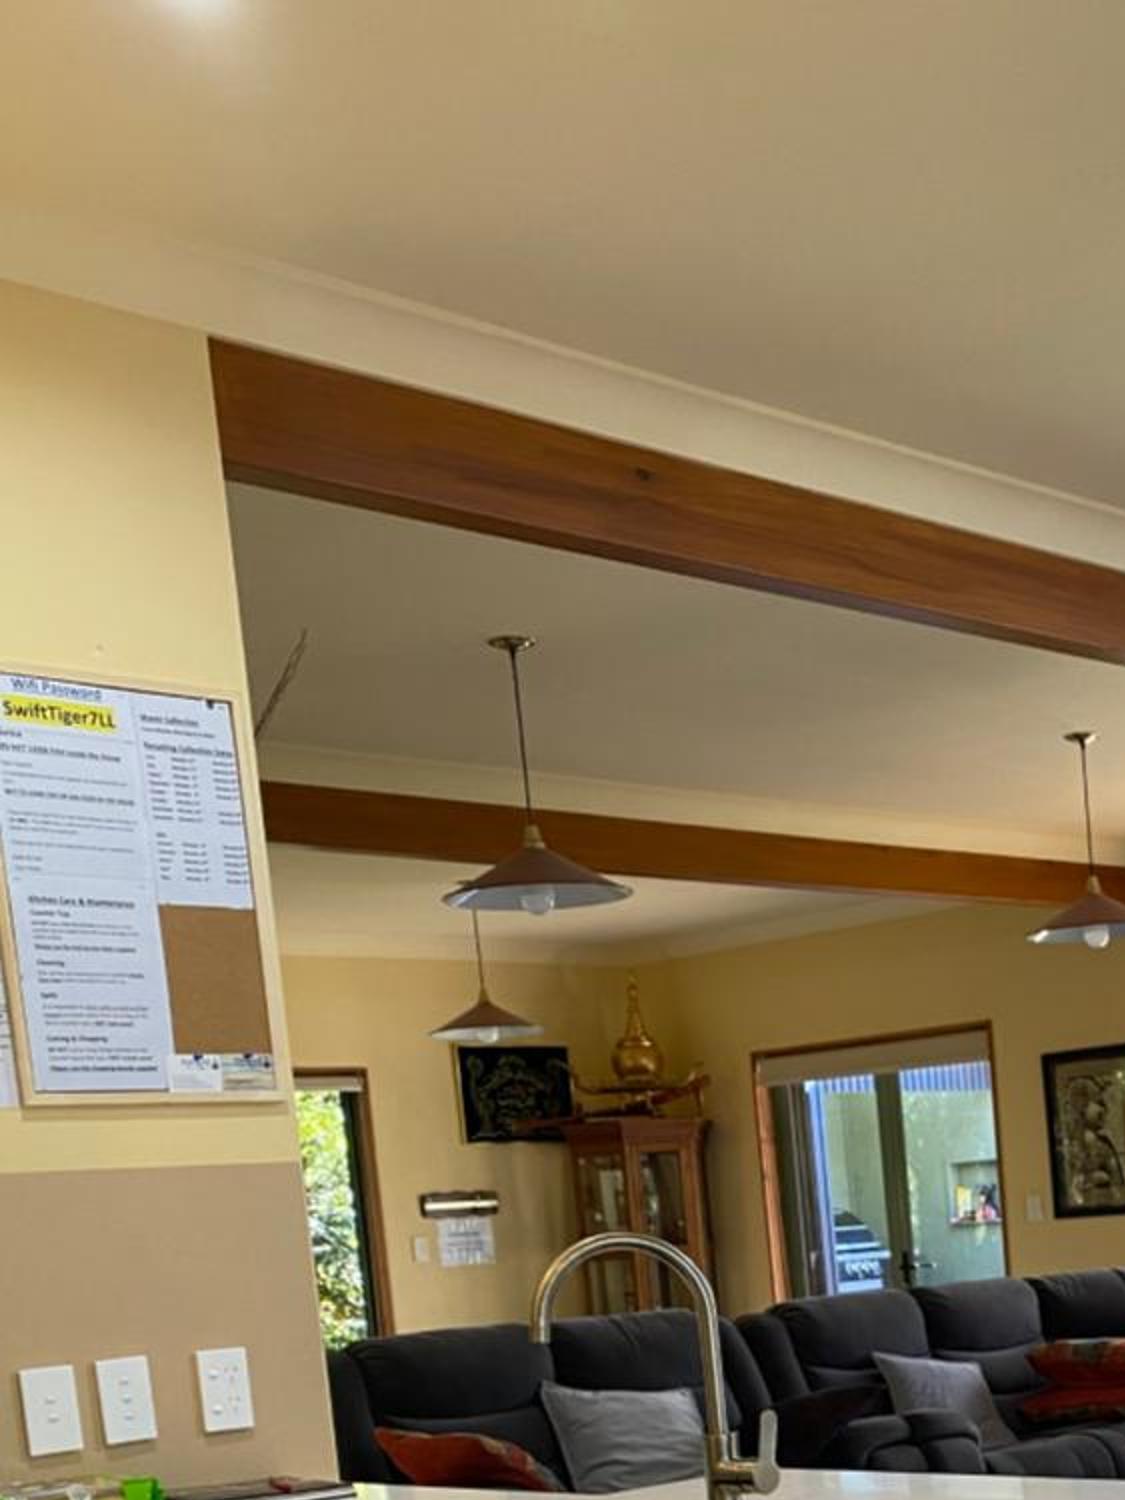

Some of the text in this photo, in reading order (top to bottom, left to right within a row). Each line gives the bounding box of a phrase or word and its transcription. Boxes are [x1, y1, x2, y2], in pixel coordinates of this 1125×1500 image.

[11, 678, 101, 699] Wifi Password
[3, 700, 116, 728] SwiftTiger7LL
